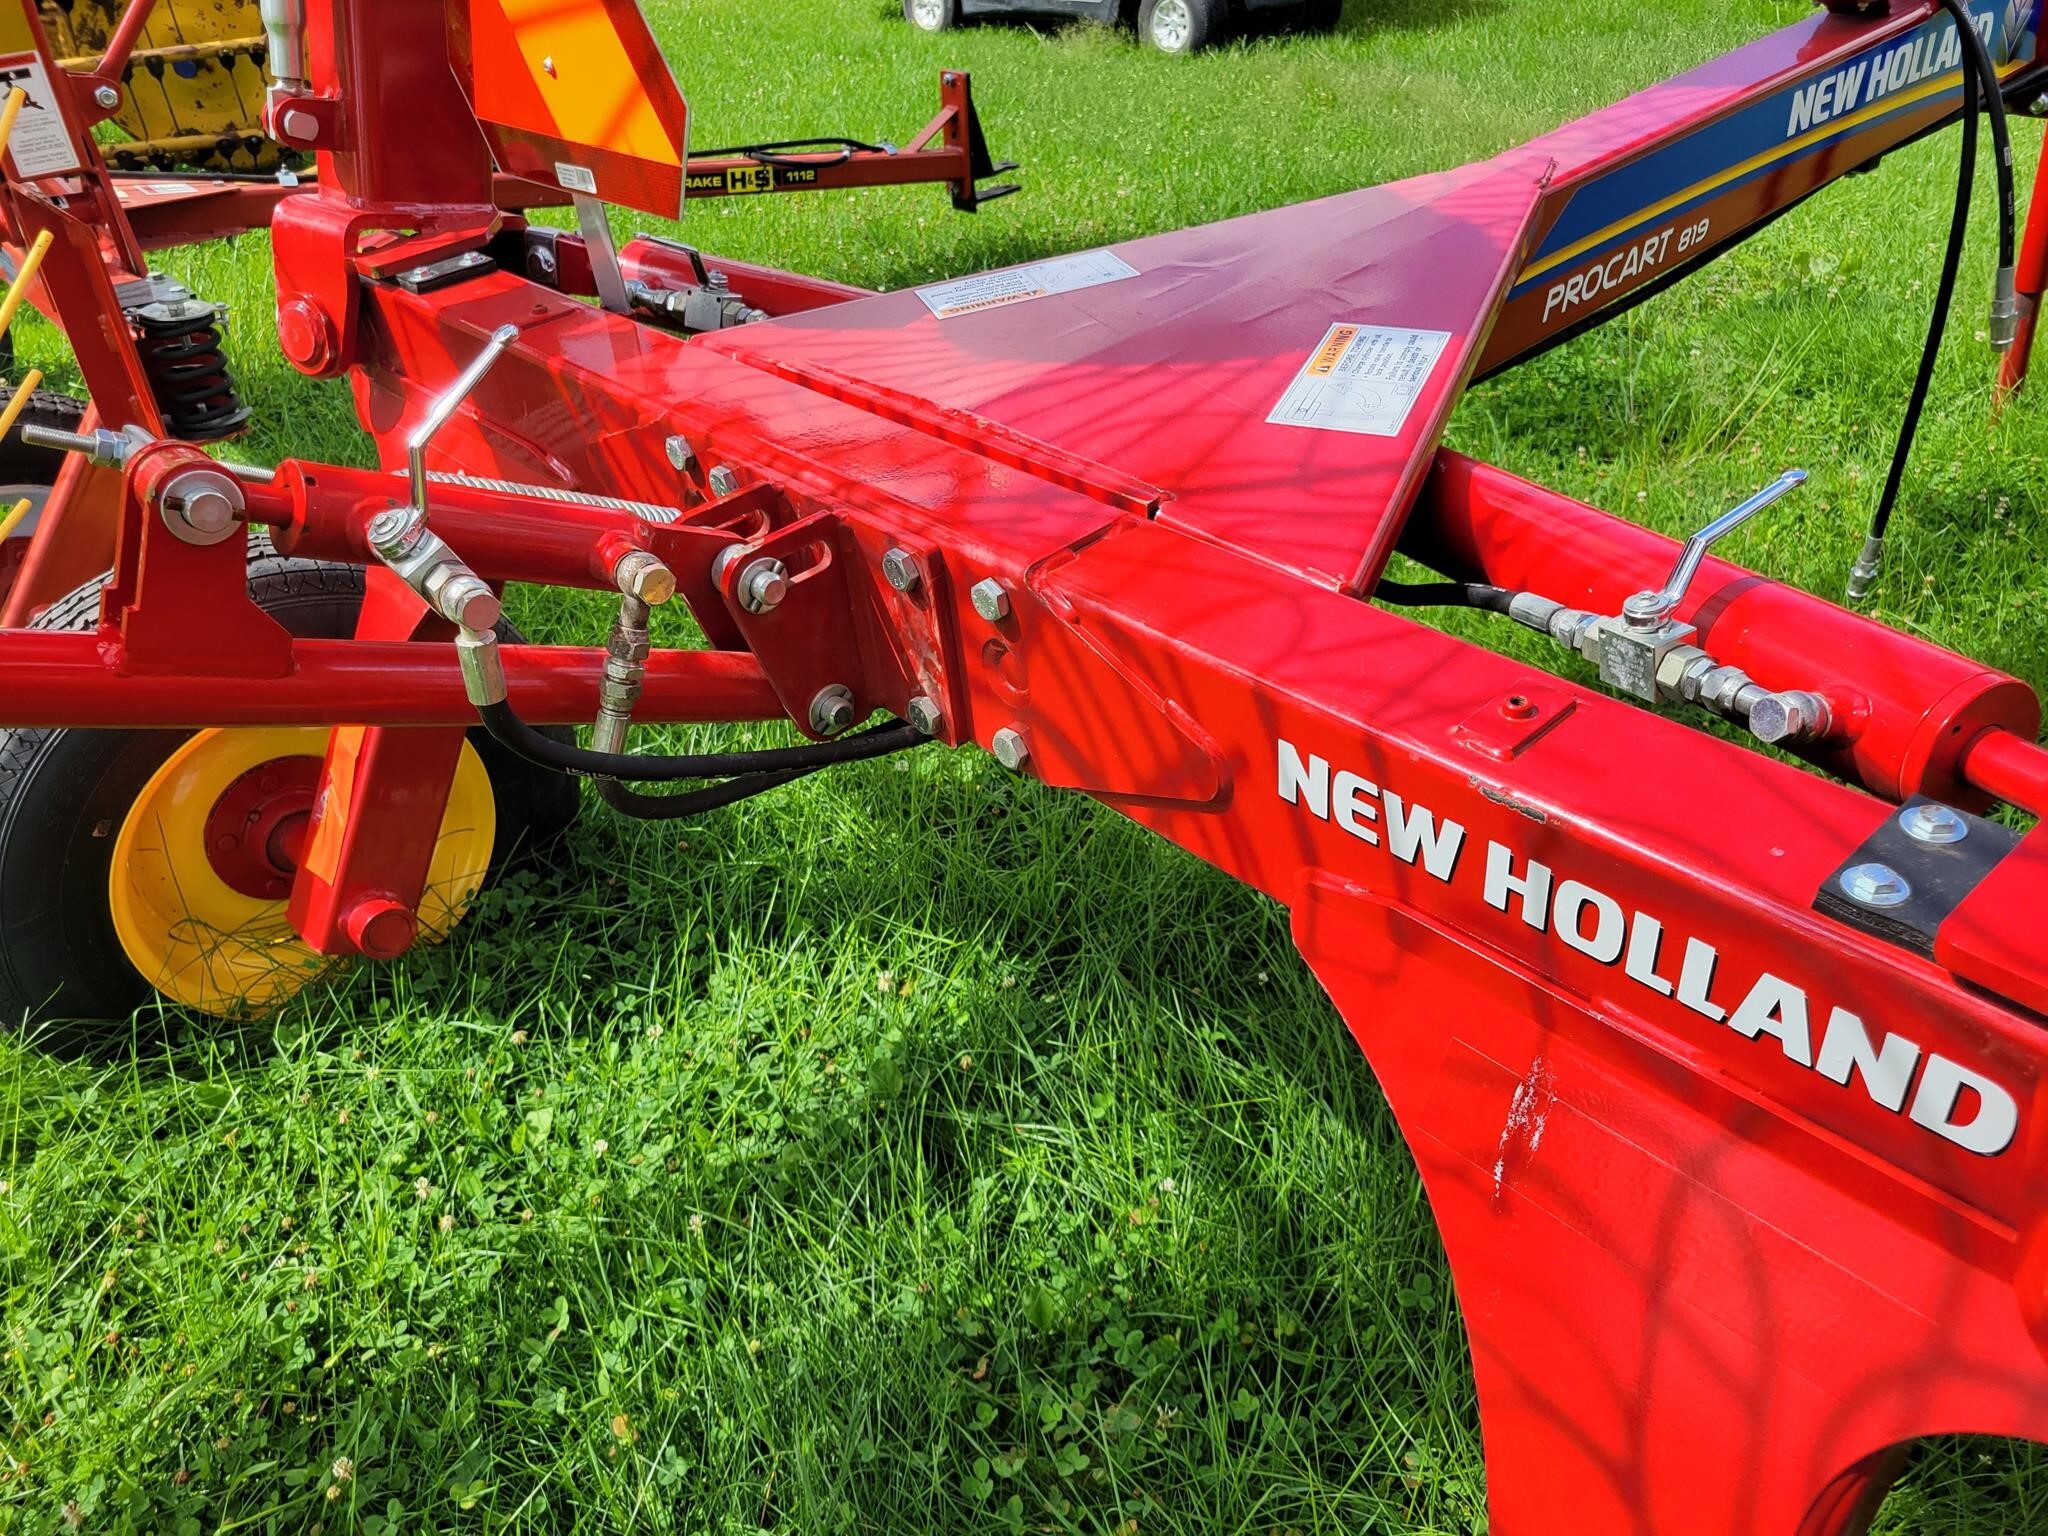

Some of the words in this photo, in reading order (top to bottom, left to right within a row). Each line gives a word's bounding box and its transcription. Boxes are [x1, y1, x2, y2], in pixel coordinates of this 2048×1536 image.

[1787, 61, 1867, 138] NEW
[787, 170, 815, 181] 1112
[1542, 228, 1674, 323] PROCART
[1678, 218, 1709, 253] 819
[1320, 330, 1353, 363] WARNING
[1278, 738, 1466, 882] NEW
[1484, 839, 2018, 1156] HOLLAND
